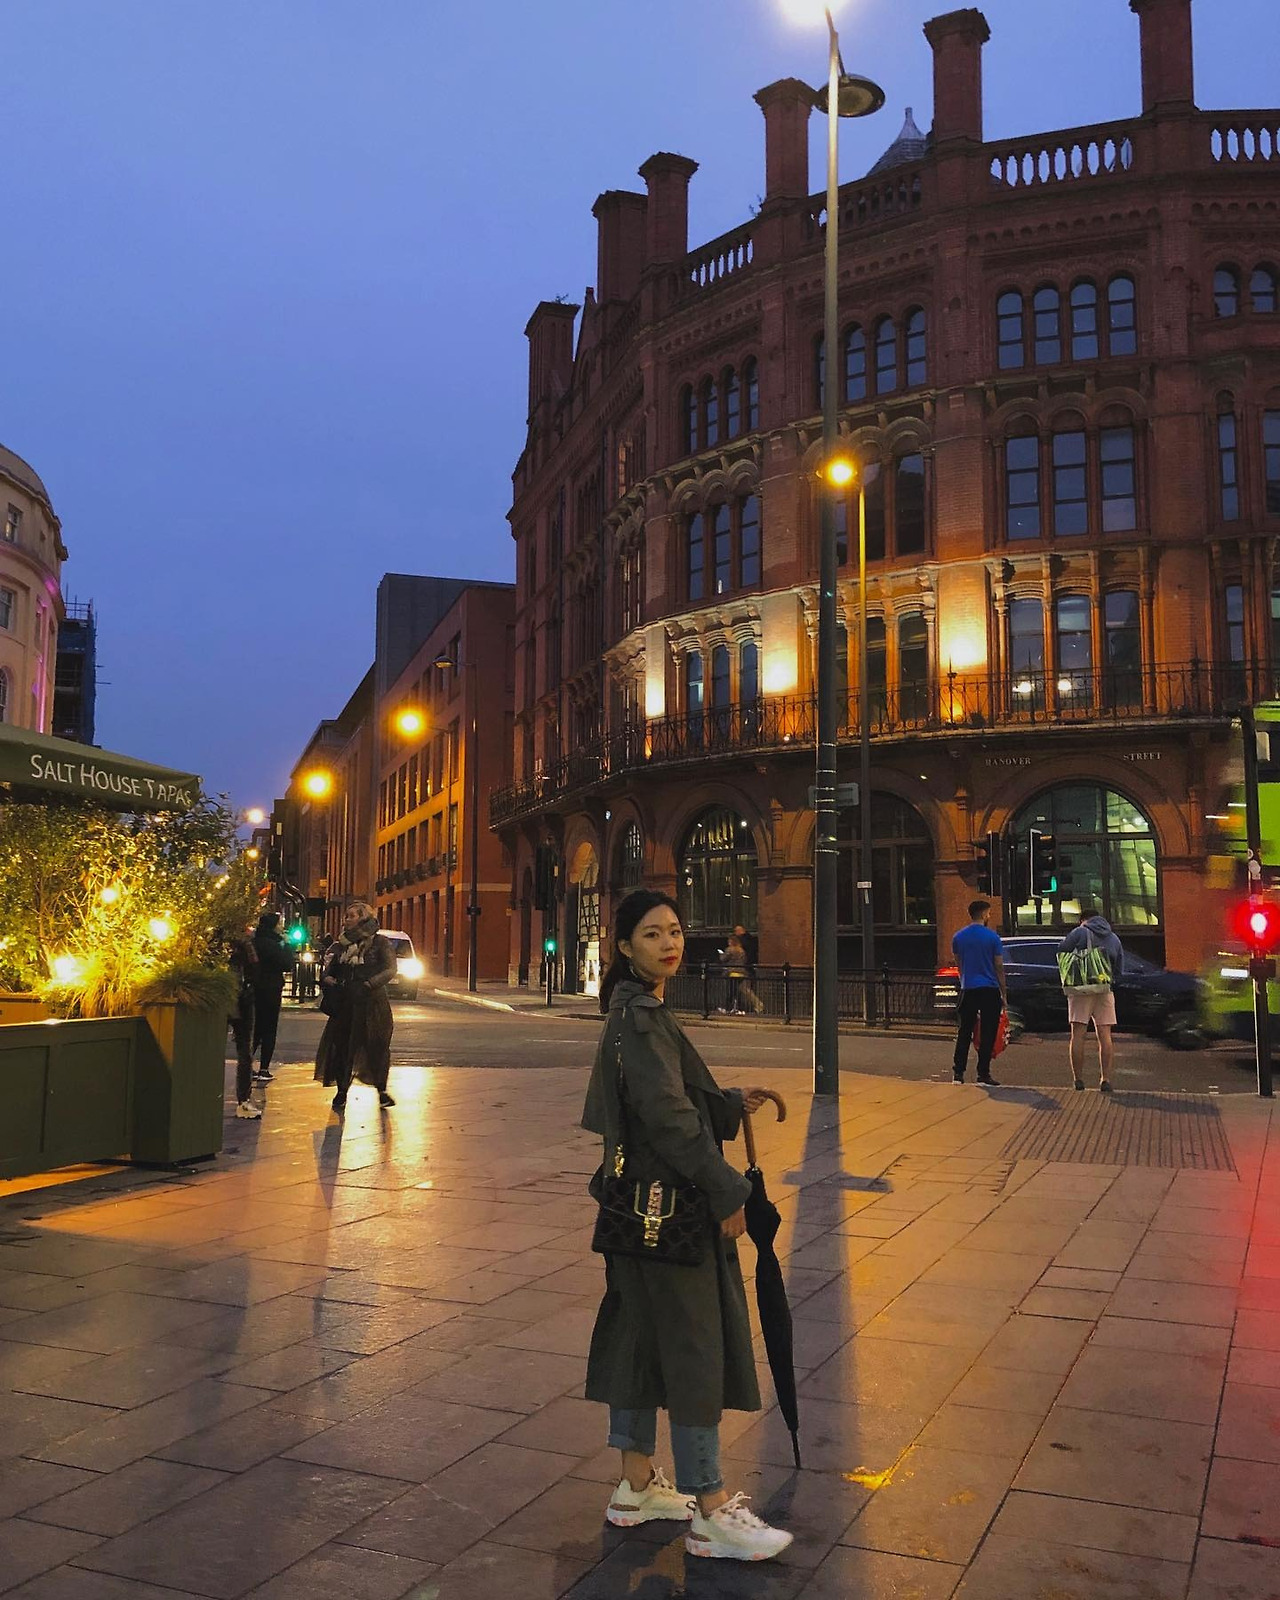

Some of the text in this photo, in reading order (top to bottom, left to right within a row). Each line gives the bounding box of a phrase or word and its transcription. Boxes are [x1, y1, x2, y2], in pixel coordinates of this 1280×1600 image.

[985, 752, 1162, 767] HANOVER STREET
[31, 754, 192, 806] SALT HOUSE TAPAS
